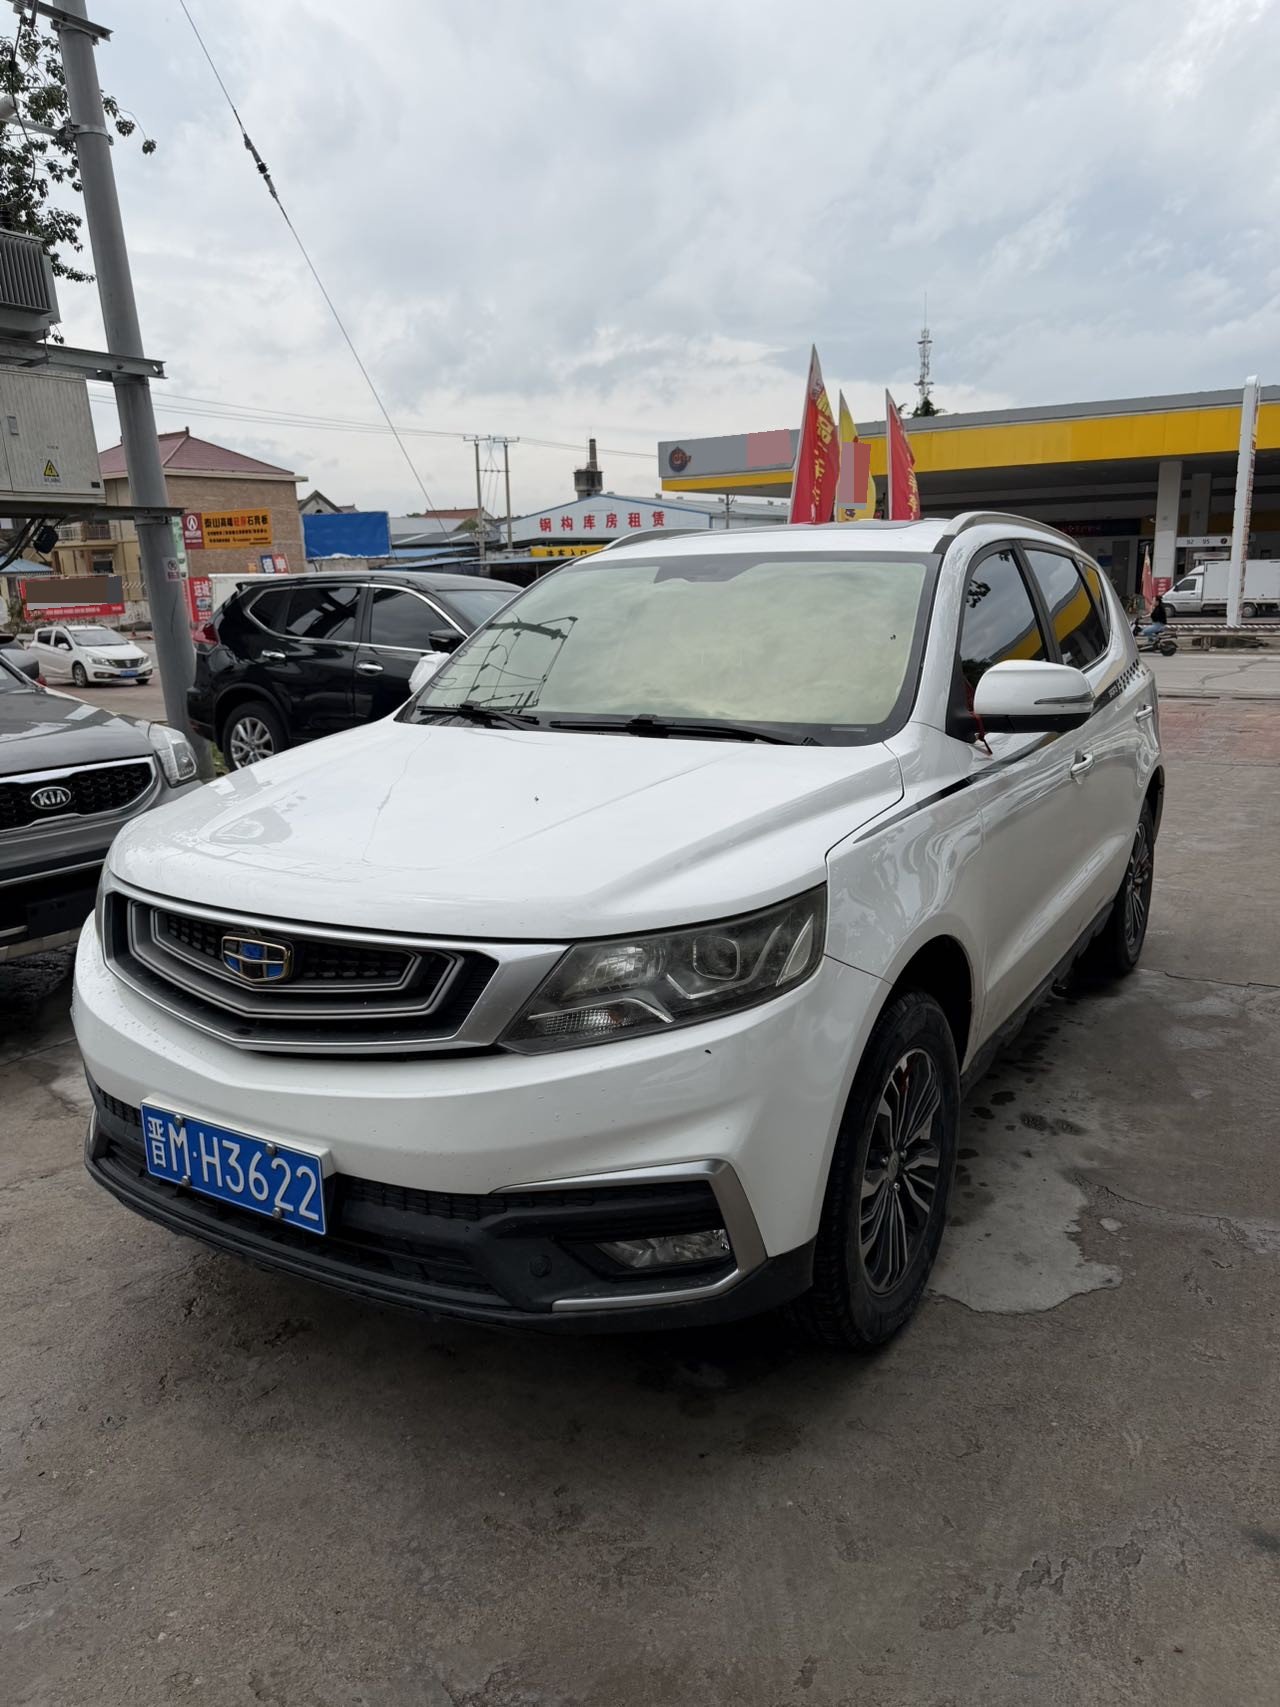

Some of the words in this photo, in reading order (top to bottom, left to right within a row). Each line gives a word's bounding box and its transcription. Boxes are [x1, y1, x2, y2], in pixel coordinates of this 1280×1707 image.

[539, 511, 665, 532] 钢构库房租赁
[37, 790, 66, 806] KIA
